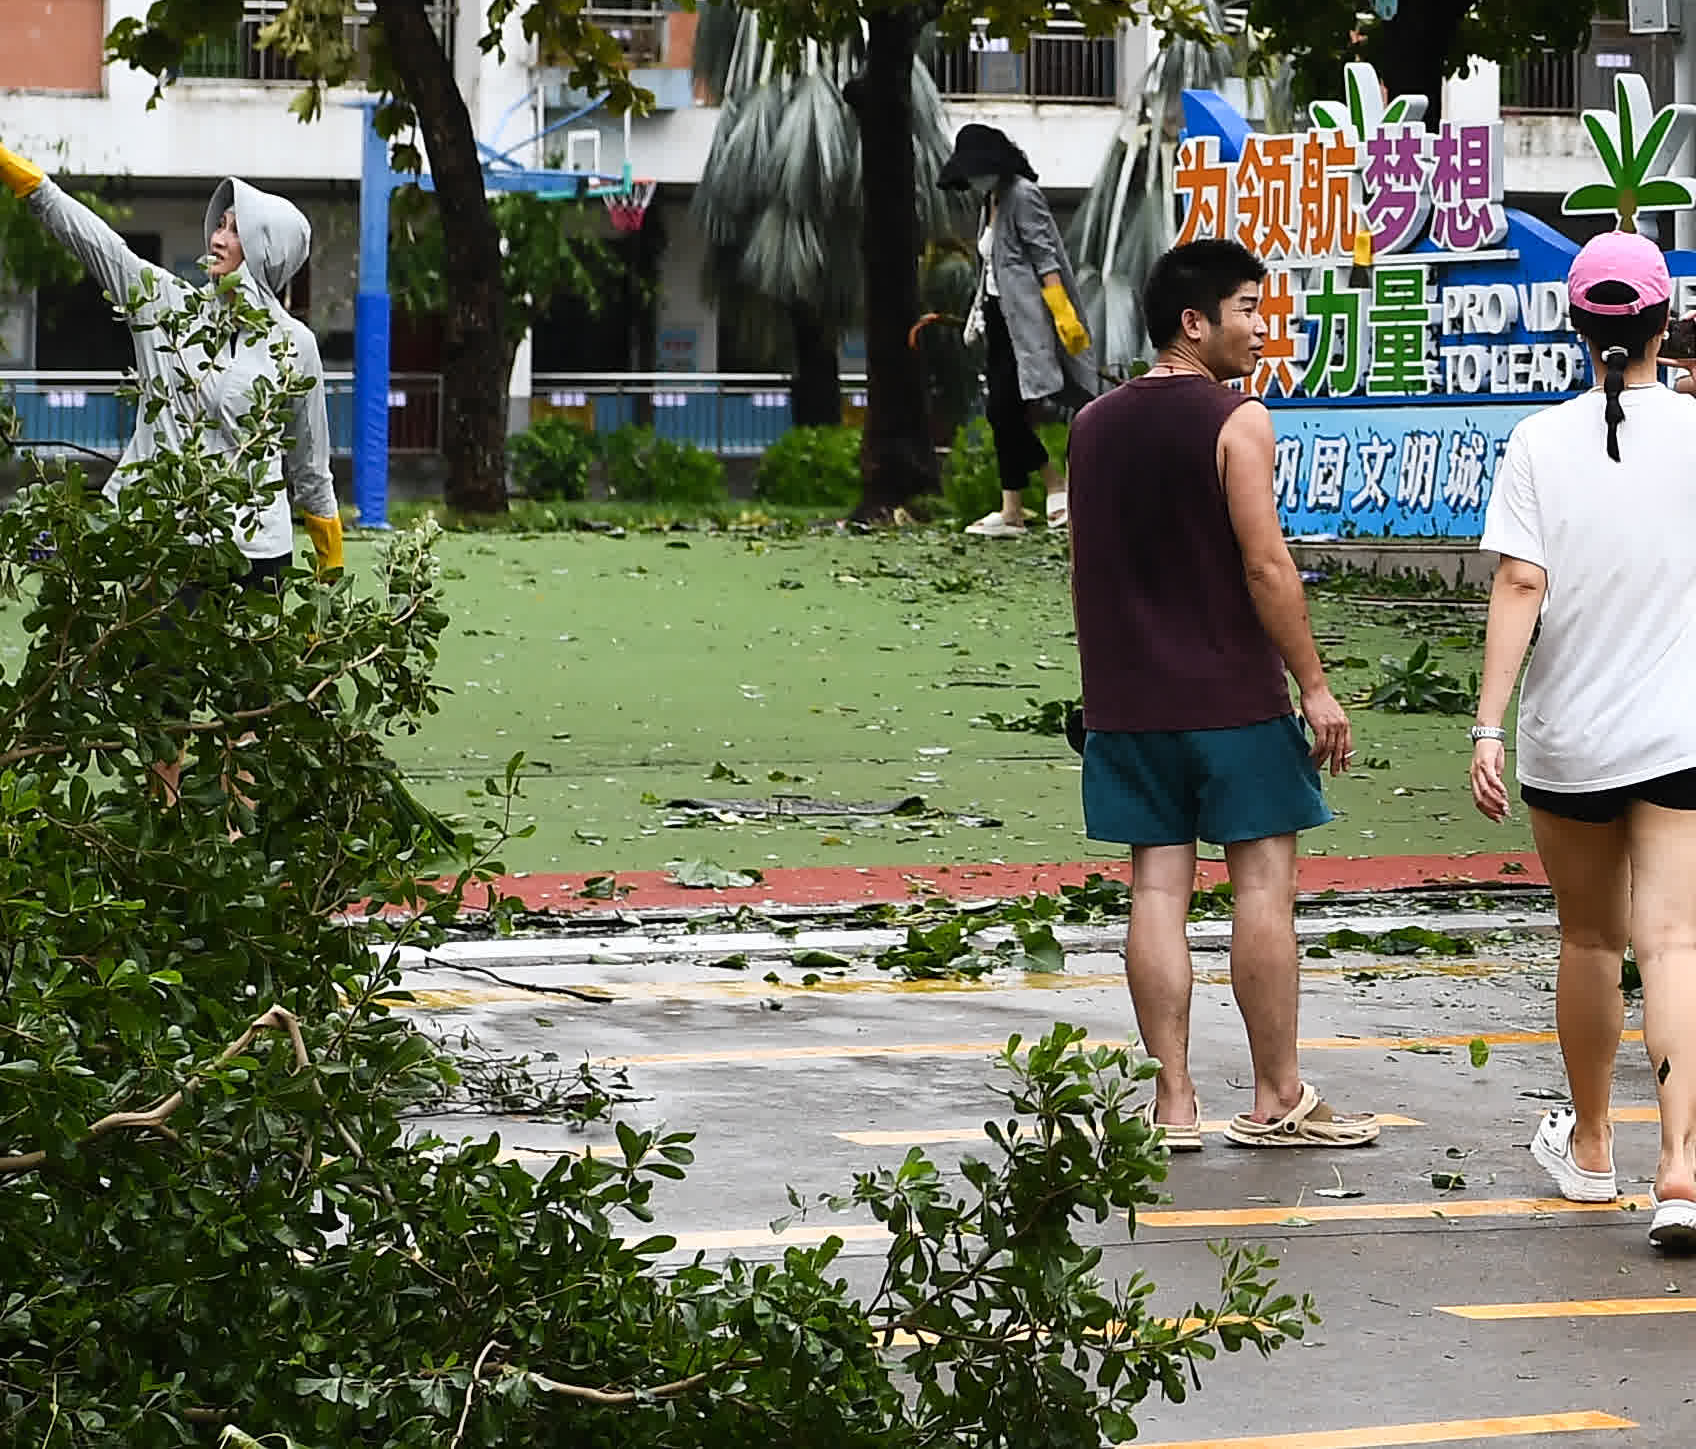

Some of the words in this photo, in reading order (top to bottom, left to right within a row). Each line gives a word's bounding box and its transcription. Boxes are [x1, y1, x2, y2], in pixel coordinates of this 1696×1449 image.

[1174, 122, 1497, 256] 为领航梦想
[1442, 282, 1574, 334] PROVID
[1273, 434, 1508, 510] 巩固文明城
